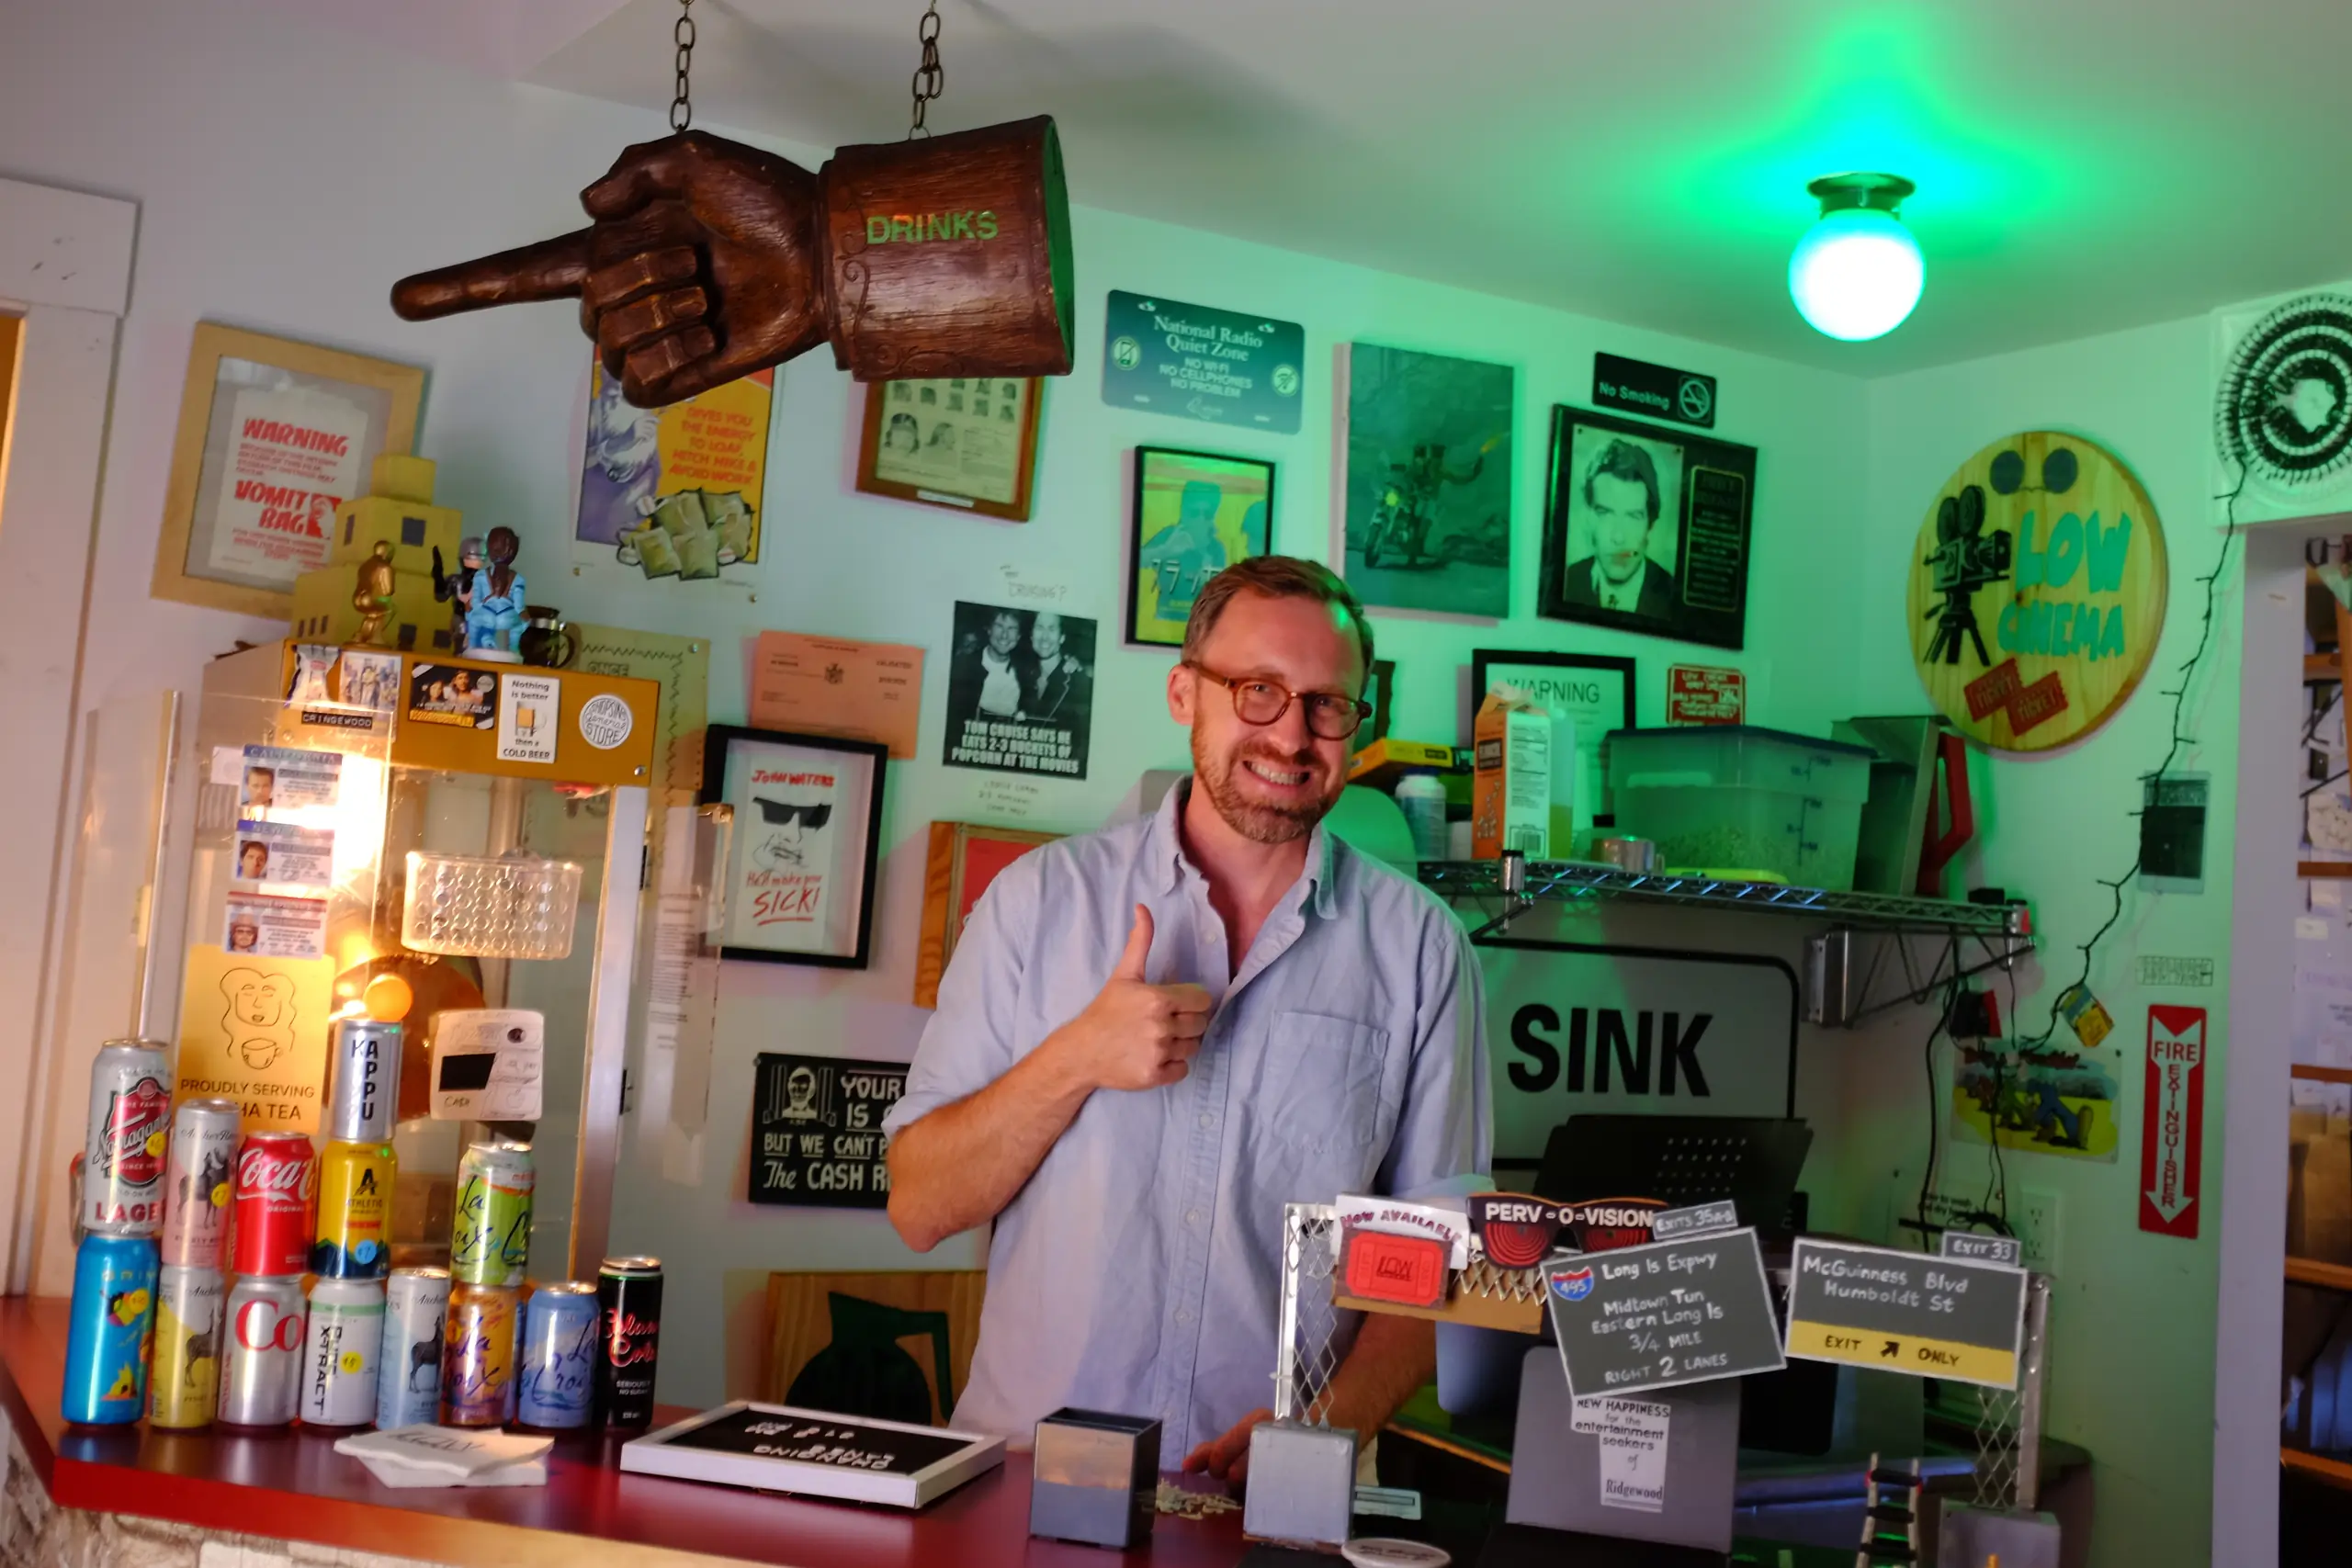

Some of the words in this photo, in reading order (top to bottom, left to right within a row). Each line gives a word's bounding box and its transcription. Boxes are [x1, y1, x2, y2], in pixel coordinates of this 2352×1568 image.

[866, 210, 999, 244] DRINKS
[1154, 315, 1216, 340] National
[1220, 327, 1263, 348] Radio
[1166, 333, 1208, 354] Quiet
[1211, 342, 1250, 361] Zone
[1184, 357, 1202, 369] NO
[1159, 364, 1178, 377] NO
[1180, 367, 1252, 389] CELLPHONES
[1170, 378, 1188, 389] NO
[1189, 380, 1241, 398] PROBLEM
[1599, 381, 1616, 396] No
[1619, 386, 1670, 411] Smoking
[243, 418, 349, 457] WARNING
[234, 479, 310, 511] VOMIT
[258, 507, 305, 535] BAG
[2015, 510, 2133, 594] LOW
[1997, 599, 2125, 662] CINEMA
[512, 680, 550, 693] Nothing
[521, 692, 549, 700] better
[302, 713, 372, 728] CRINGEWOOD
[964, 719, 989, 735] TOM
[989, 722, 1030, 739] CRUISE
[1030, 727, 1057, 743] SAYS
[585, 722, 620, 747] STORE
[961, 734, 988, 750] EATS
[989, 737, 1009, 752] 2-3
[1009, 739, 1057, 757] BUCKETS
[250, 748, 336, 765] CALIFORNIA
[503, 748, 526, 758] COLD
[528, 750, 550, 760] BEER
[951, 746, 1003, 765] POPCORN
[1003, 753, 1018, 767] AT
[1018, 754, 1038, 769] THE
[1038, 757, 1080, 774] MOVIES
[752, 770, 787, 784] JOHN
[788, 773, 835, 788] WATERS
[771, 872, 802, 886] make
[752, 887, 821, 919] SICK!
[1508, 1003, 1714, 1097] SINK
[2154, 1041, 2198, 1063] FIRE
[180, 1078, 248, 1096] PROUDLY
[253, 1082, 315, 1099] SERVING
[840, 1076, 902, 1100] YOUR
[268, 1104, 302, 1121] TEA
[846, 1102, 869, 1129] IS
[763, 1133, 794, 1153] BUT
[799, 1134, 826, 1155] WE
[832, 1133, 876, 1156] CAN'T
[2161, 1063, 2181, 1210] EXTINGUISHER
[238, 1147, 302, 1190] Coca
[763, 1160, 798, 1190] The
[806, 1162, 865, 1190] CASH
[1340, 1211, 1375, 1229] NOW
[1656, 1215, 1692, 1232] EXITS
[1952, 1239, 1988, 1256] EXIT
[1990, 1242, 2012, 1260] 33
[1377, 1255, 1414, 1280] LOW
[1601, 1262, 1640, 1280] Long
[1646, 1258, 1660, 1273] Is
[1667, 1252, 1717, 1274] Expwy
[1803, 1256, 1908, 1286] McGuinness
[1925, 1271, 1969, 1293] Blvd
[1560, 1280, 1588, 1294] 495
[1824, 1280, 1920, 1309] Humboldt
[1929, 1294, 1955, 1314] St
[1603, 1296, 1668, 1316] Midtown
[1670, 1289, 1705, 1304] Tun
[1591, 1316, 1657, 1335] Eastern
[1662, 1308, 1702, 1326] Long
[1706, 1302, 1724, 1320] Is
[1628, 1332, 1661, 1354] 3/4
[1668, 1331, 1702, 1348] MILE
[1825, 1335, 1862, 1352] EXIT
[1917, 1347, 1961, 1367] ONLY
[1604, 1365, 1652, 1384] RIGHT
[1659, 1356, 1678, 1377] 2
[1684, 1353, 1729, 1371] LANES
[1577, 1398, 1602, 1412] NEW
[1605, 1401, 1671, 1419] HAPPINESS
[1604, 1413, 1620, 1424] for
[1624, 1414, 1642, 1427] the
[1575, 1420, 1664, 1440] entertainment
[1601, 1435, 1655, 1451] seekers
[1627, 1453, 1639, 1472] of
[1605, 1479, 1663, 1501] Ridgewood
